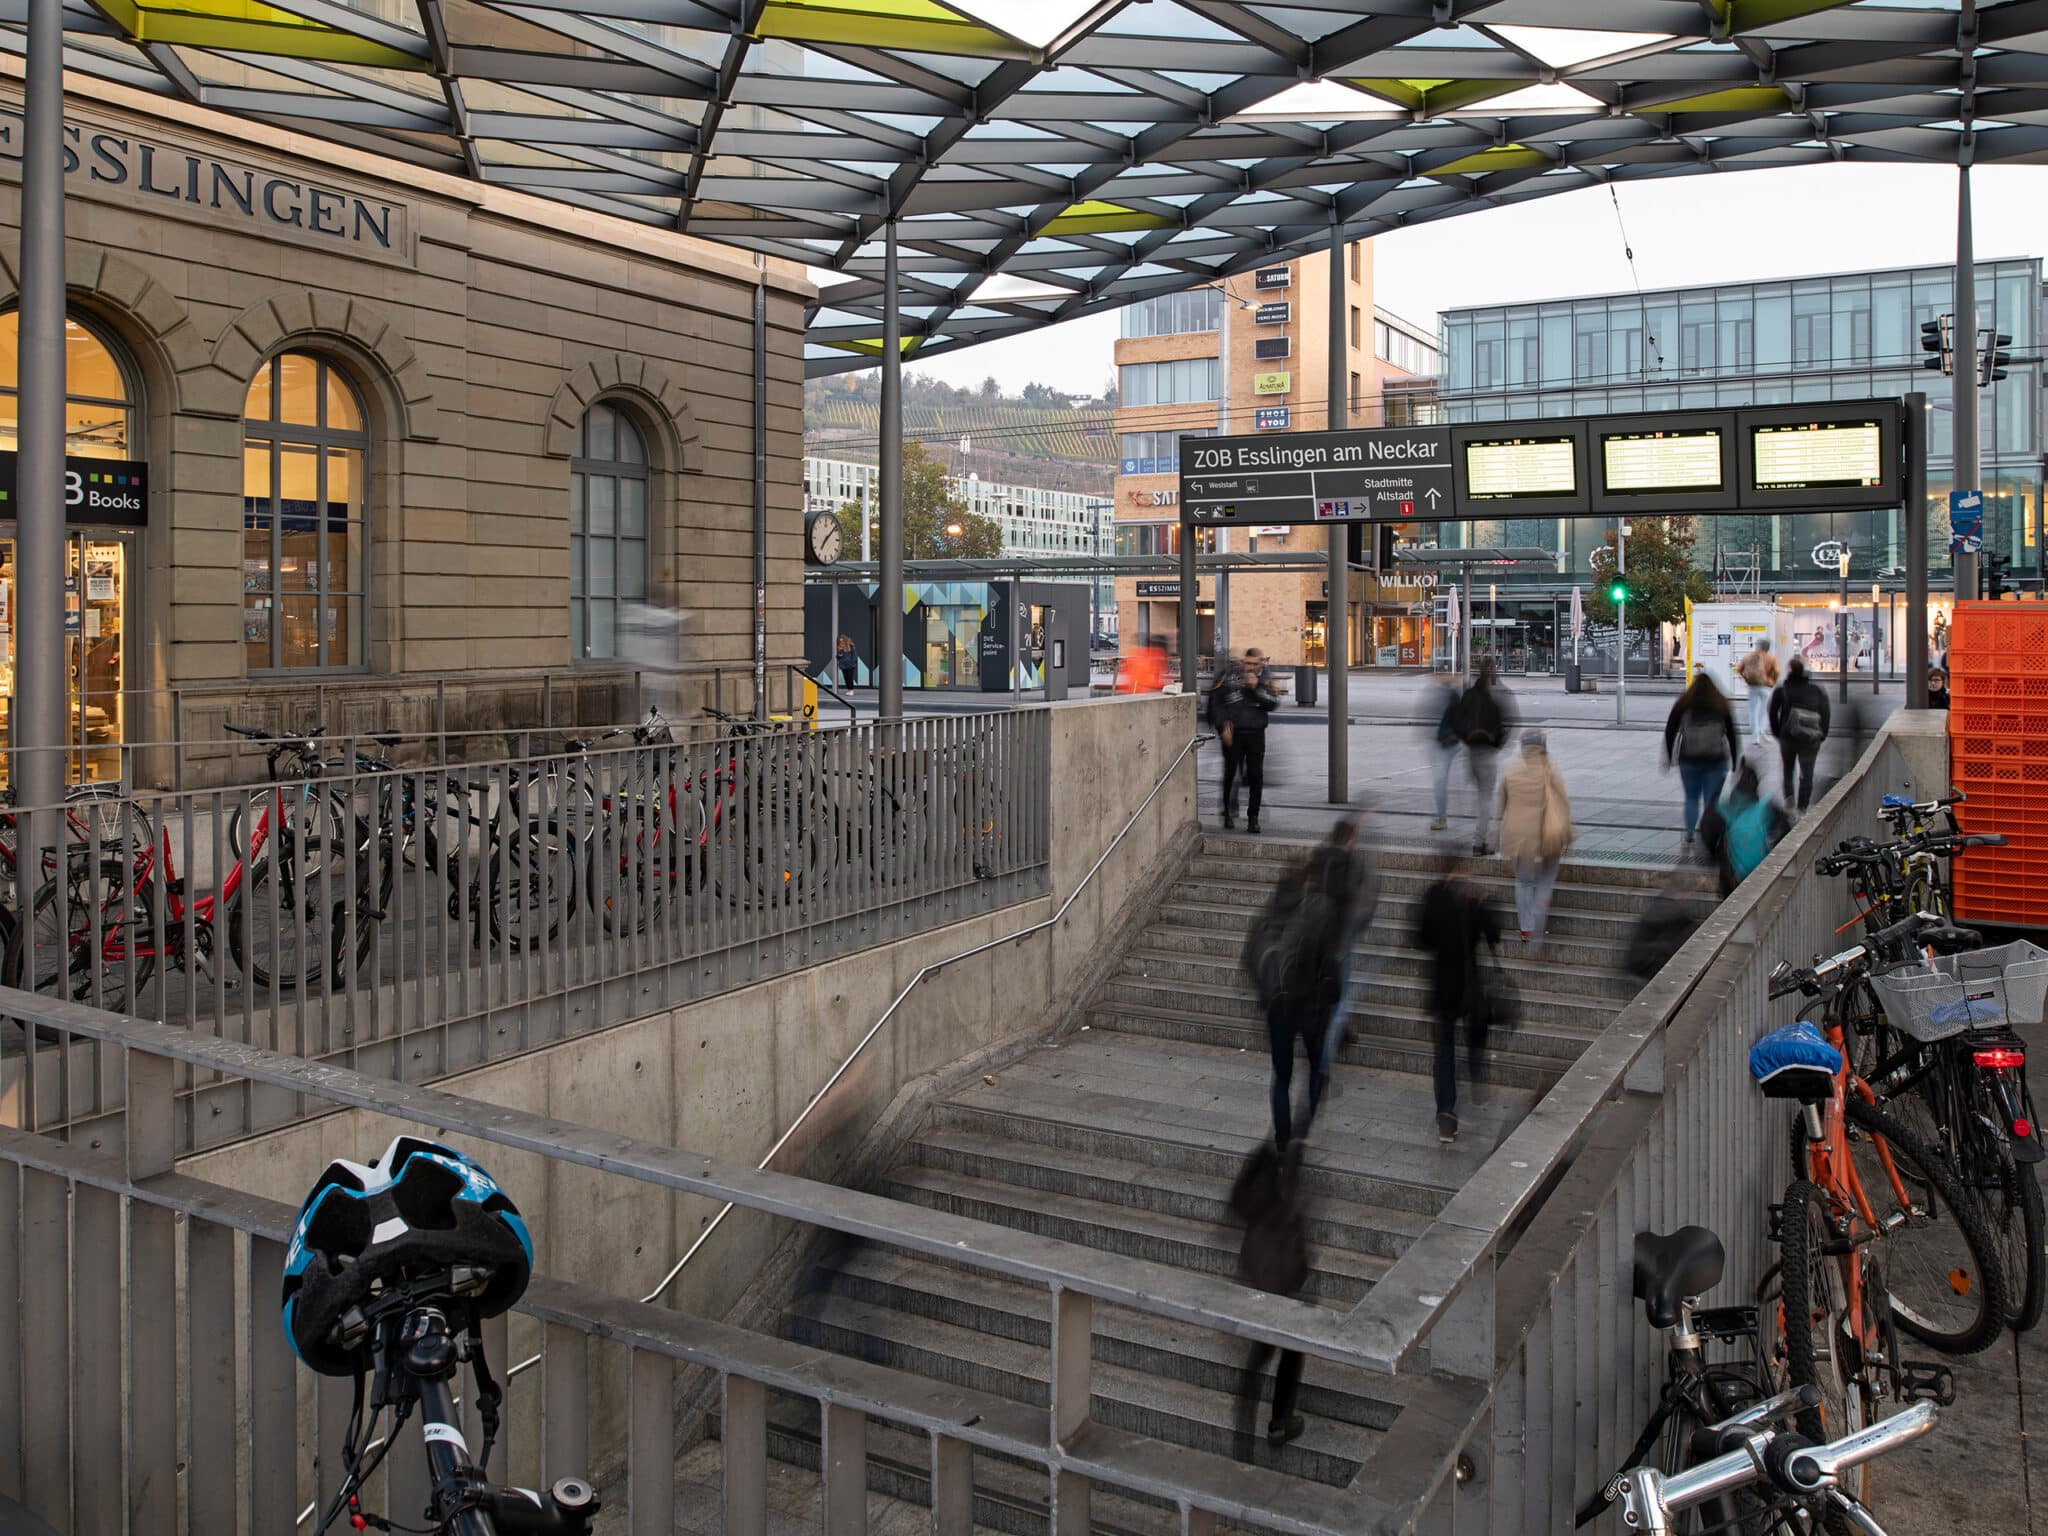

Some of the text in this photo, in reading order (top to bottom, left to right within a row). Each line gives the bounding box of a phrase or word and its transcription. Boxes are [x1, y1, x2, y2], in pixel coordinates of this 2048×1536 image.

[1193, 449, 1232, 468] ZOB
[1238, 446, 1327, 468] Esslingen
[1333, 446, 1362, 462] am
[1368, 439, 1439, 460] Neckar
[1208, 481, 1238, 489] Weststadt
[1364, 477, 1413, 488] Stadtmitte
[89, 490, 141, 510] Books
[1376, 490, 1414, 501] Altstadt
[1050, 609, 1056, 623] 7
[1402, 647, 1415, 659] ES
